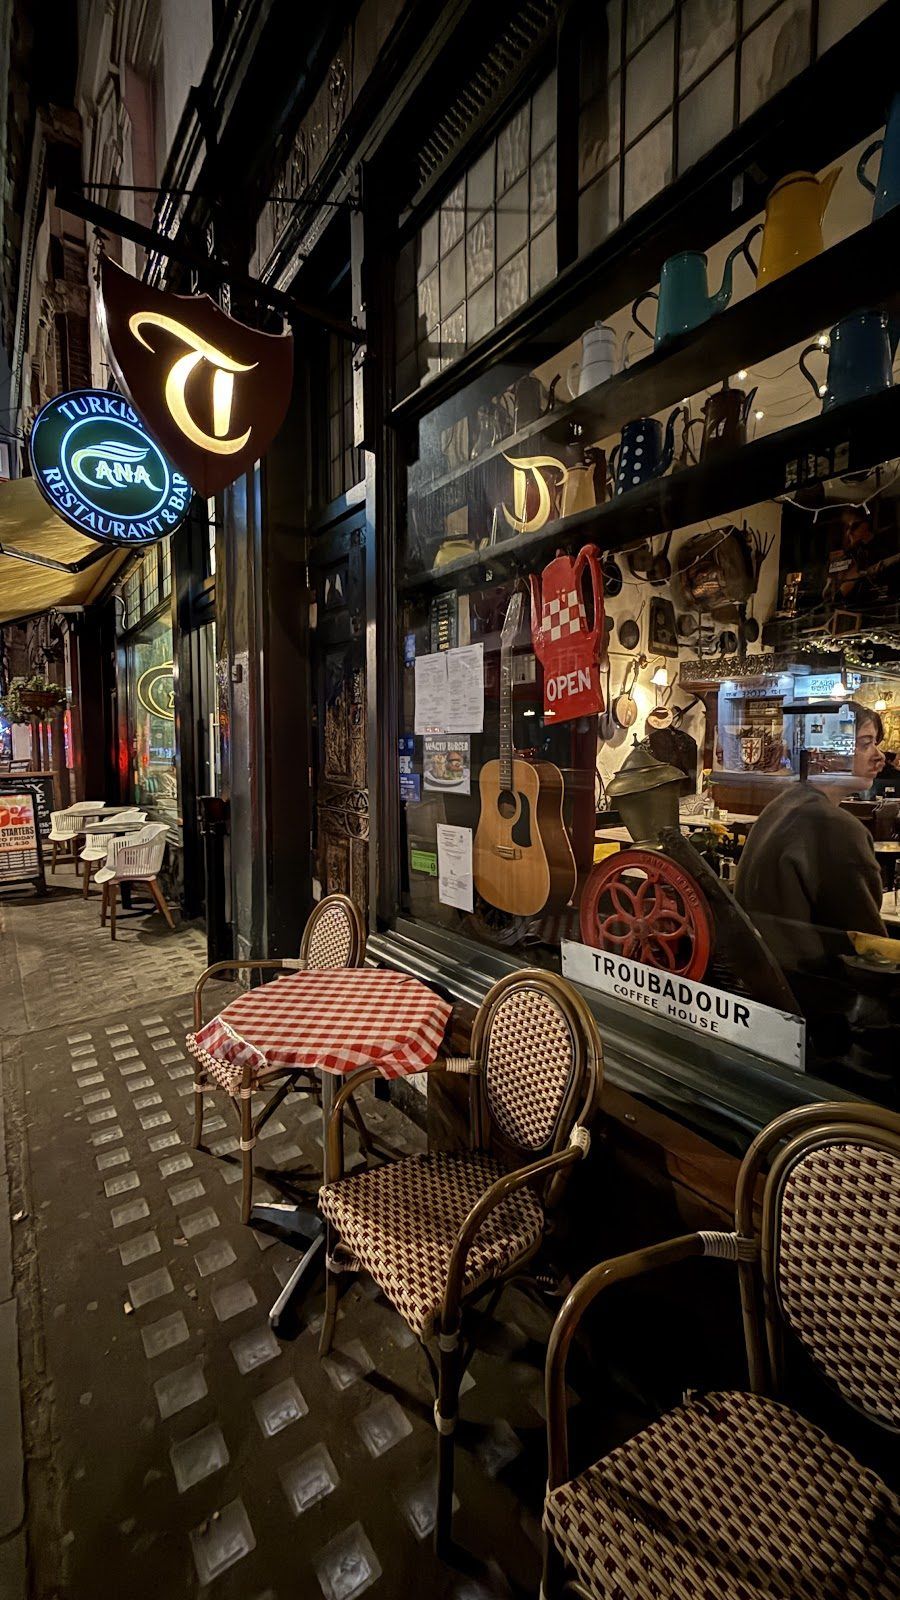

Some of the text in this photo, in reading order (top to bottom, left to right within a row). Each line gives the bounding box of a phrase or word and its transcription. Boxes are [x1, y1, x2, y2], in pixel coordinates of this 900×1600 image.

[57, 397, 143, 428] TURKIS
[43, 468, 190, 539] RESTAURANT & BAR
[546, 666, 591, 702] OPEN
[447, 741, 469, 752] BURGER
[1, 826, 35, 838] STARTERS
[592, 953, 750, 1028] TROUBADOUR
[614, 984, 719, 1033] COFFEE HOUSE
